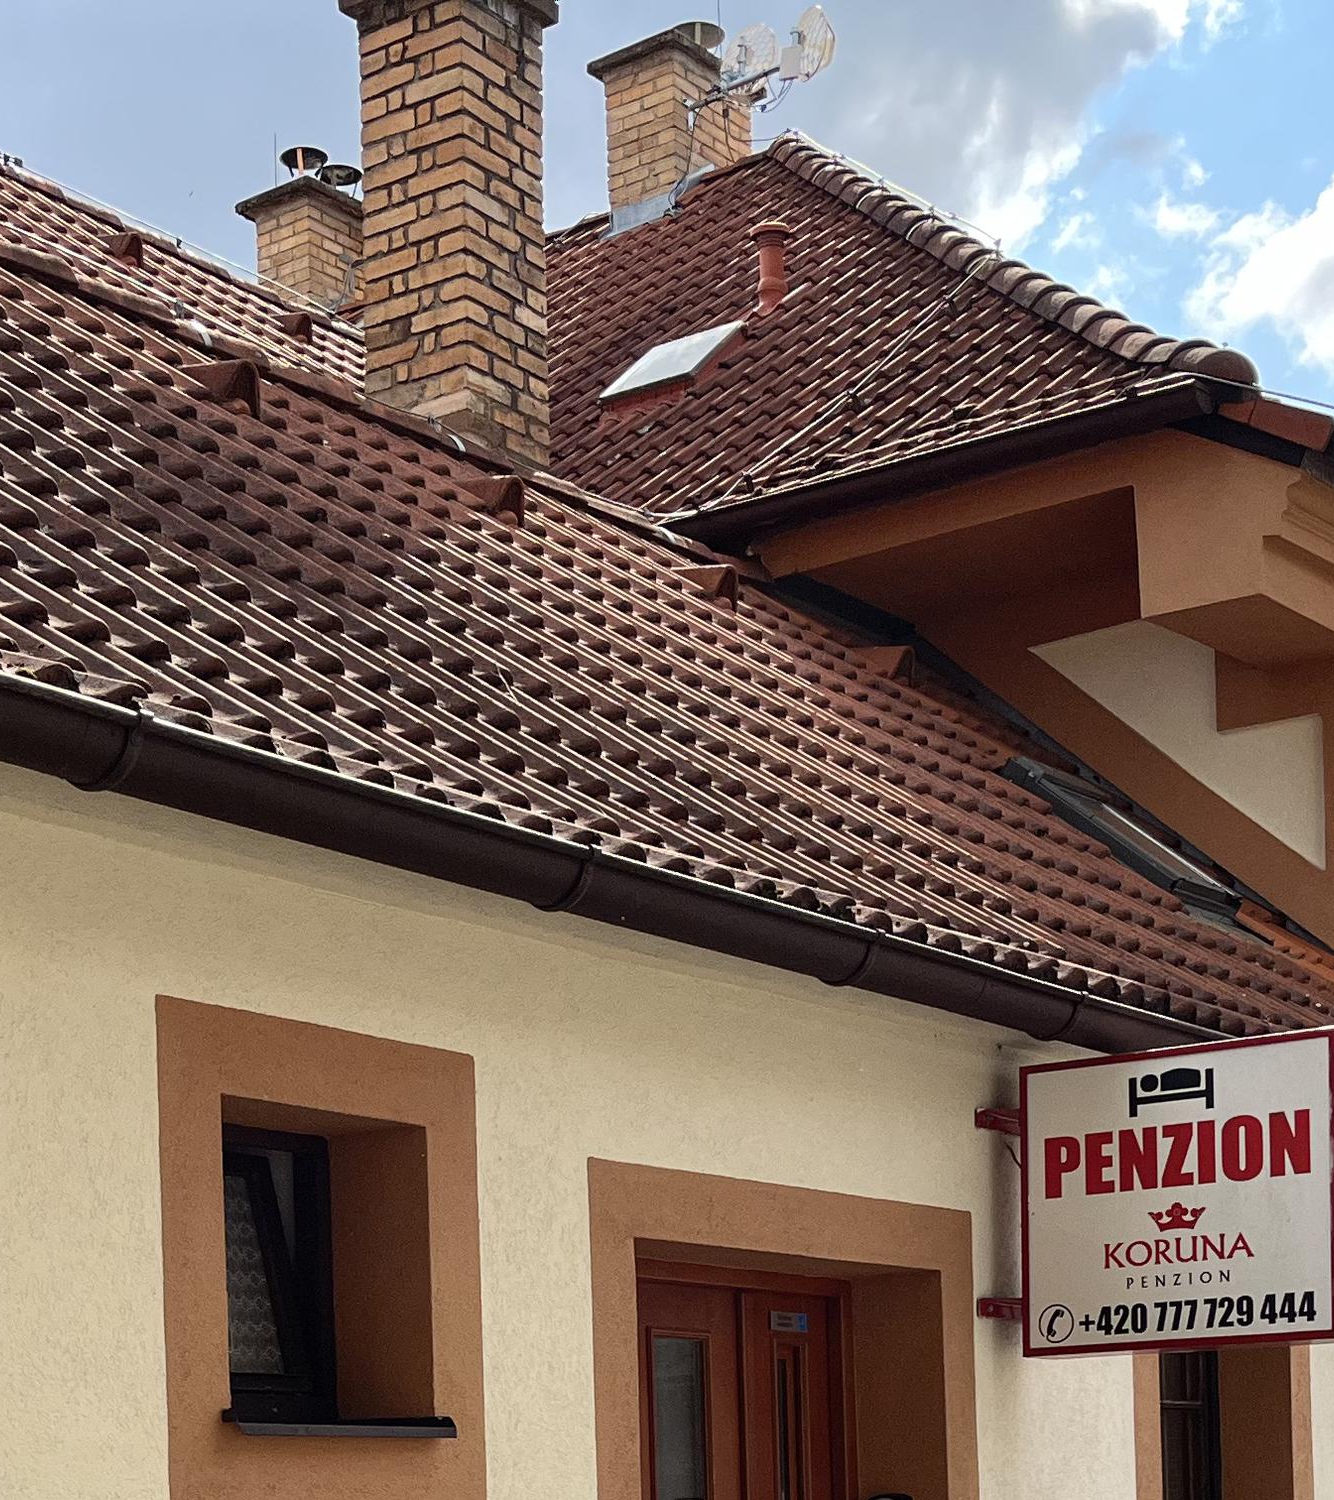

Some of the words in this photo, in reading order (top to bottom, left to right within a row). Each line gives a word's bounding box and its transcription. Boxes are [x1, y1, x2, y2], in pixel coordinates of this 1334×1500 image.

[1044, 1108, 1312, 1200] PENZION
[1103, 1232, 1255, 1269] KORUNA
[1125, 1269, 1231, 1290] PENZION
[1078, 1303, 1148, 1336] +420
[1153, 1299, 1199, 1332] 777
[1204, 1294, 1254, 1328] 729
[1259, 1290, 1317, 1325] 444
